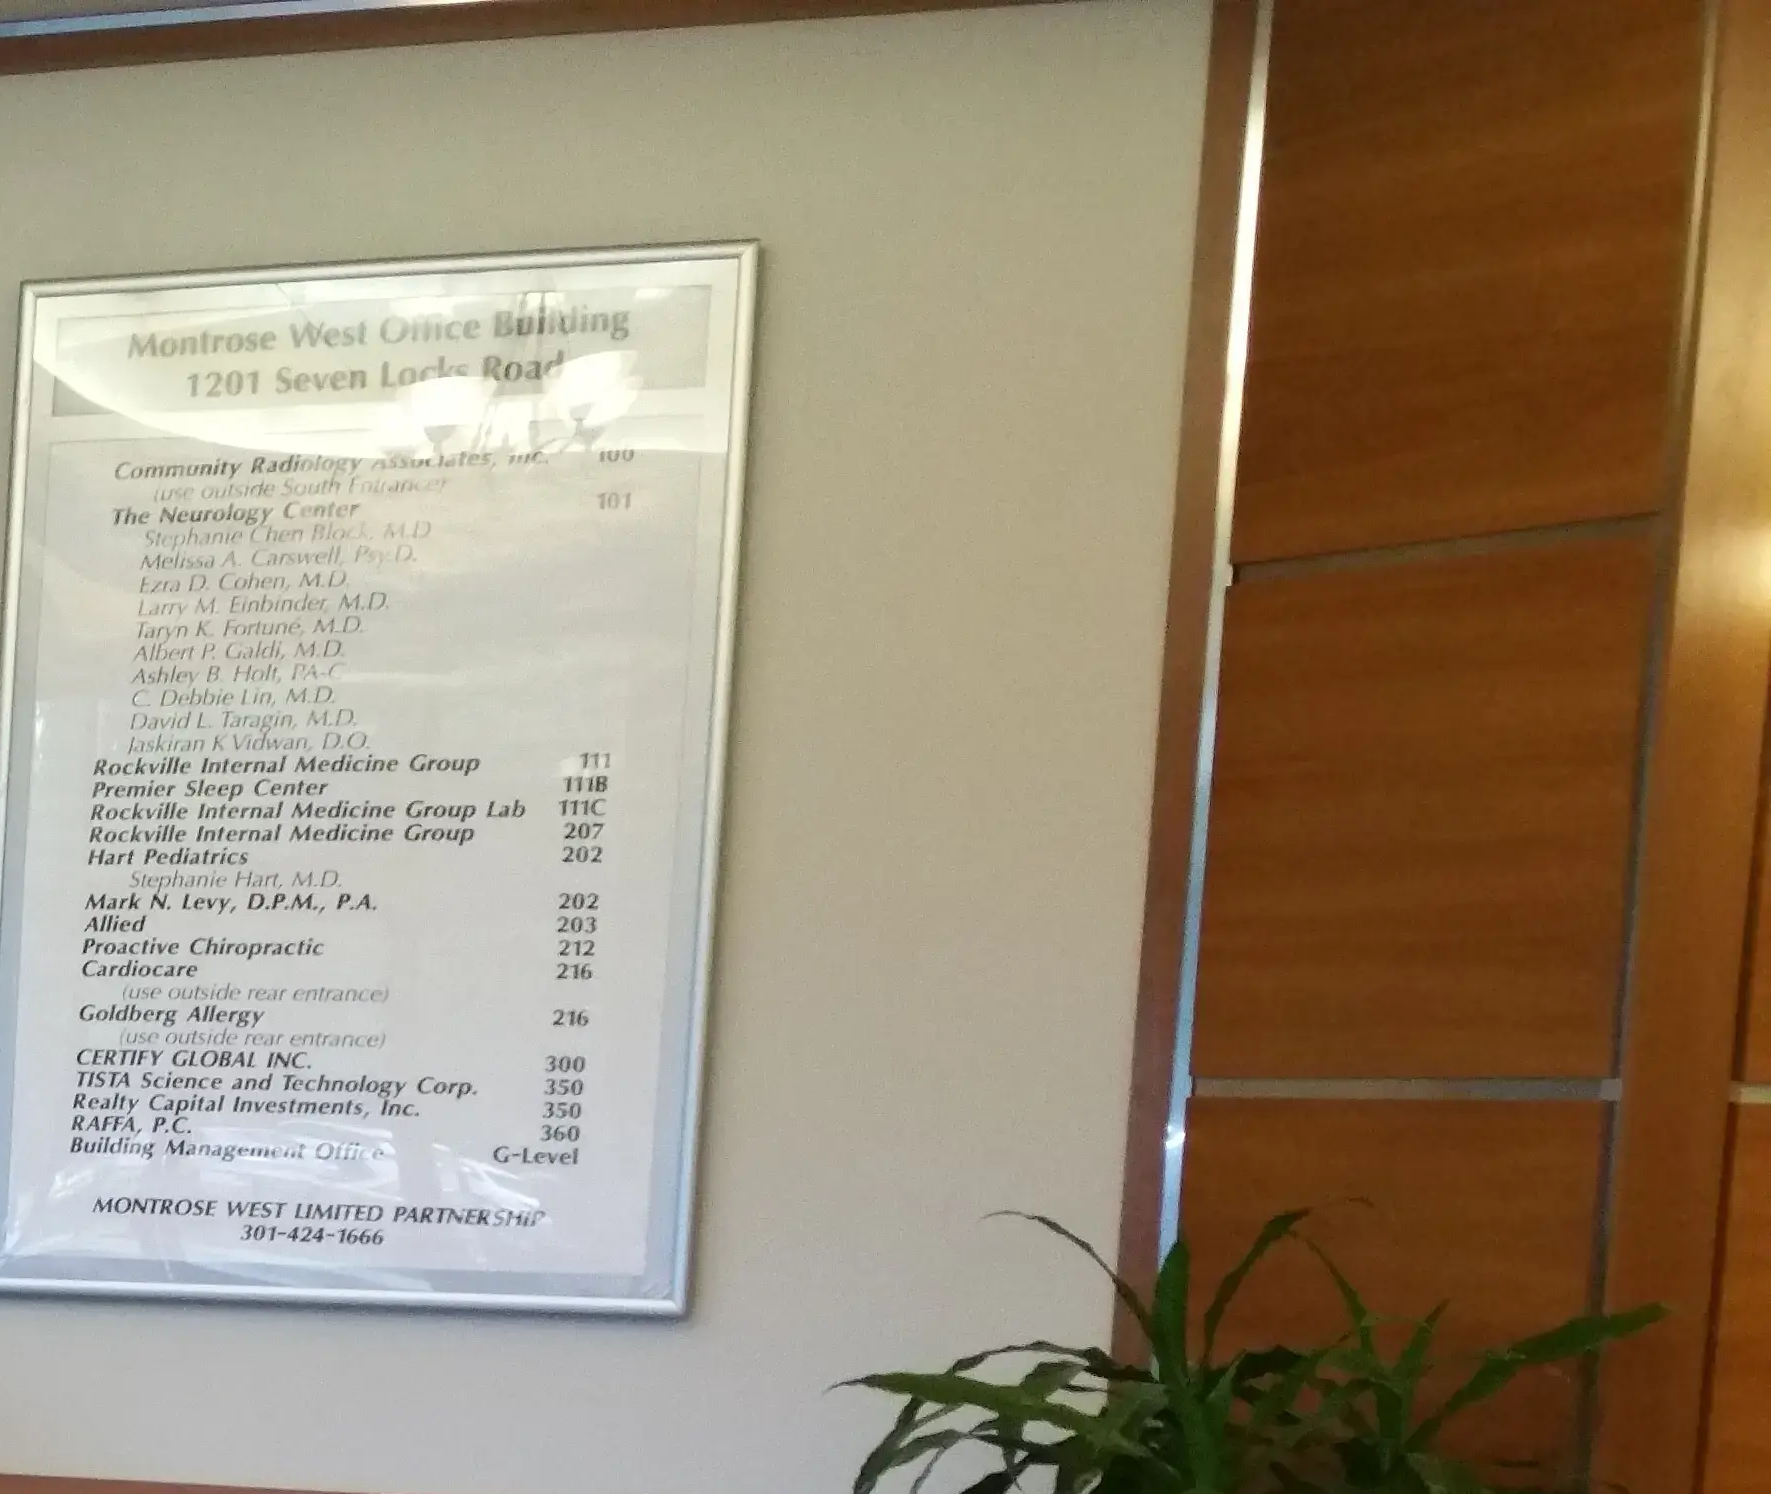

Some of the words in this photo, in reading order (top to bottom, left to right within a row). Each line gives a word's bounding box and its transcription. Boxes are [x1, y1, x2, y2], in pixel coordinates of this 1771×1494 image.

[127, 328, 276, 359] Montrose
[289, 322, 367, 348] West
[492, 308, 629, 341] Building
[187, 371, 260, 397] 1201
[275, 367, 366, 394] Seven
[114, 461, 242, 480] Community
[251, 455, 362, 475] Radiology
[112, 507, 150, 525] The
[159, 506, 273, 526] Neurology
[283, 501, 360, 519] Center
[598, 492, 632, 509] 101
[133, 645, 195, 662] Albert
[93, 757, 192, 776] Rockville
[201, 756, 286, 773] Internal
[295, 755, 399, 773] Medicine
[409, 753, 481, 776] Group
[580, 752, 610, 769] 111
[92, 781, 176, 798] Premier
[184, 780, 244, 801] Sleep
[254, 780, 328, 797] Center
[564, 776, 608, 792] 111B
[91, 803, 188, 821] Rockville
[198, 803, 284, 820] Internal
[290, 802, 395, 819] Medicine
[405, 801, 476, 822] Group
[487, 801, 525, 818] Lab
[559, 799, 607, 816] 111C
[89, 827, 187, 844] Rockville
[196, 825, 280, 842] Internal
[289, 825, 394, 842] Medicine
[404, 824, 475, 845] Group
[564, 823, 605, 840] 207
[88, 849, 134, 866] Hart
[143, 848, 248, 866] Pediatrics
[562, 847, 603, 863] 202
[84, 894, 139, 910] Mark
[150, 894, 172, 910] N.
[182, 894, 237, 913] Levy,
[247, 894, 326, 912] D.P.M.,
[336, 894, 377, 910] P.A.
[559, 893, 599, 910] 202
[84, 915, 146, 933] Allied
[558, 917, 598, 933] 203
[82, 938, 179, 955] Proactive
[189, 938, 324, 959] Chiropractic
[558, 940, 595, 957] 212
[82, 960, 198, 977] Cardiocare
[557, 963, 592, 980] 216
[79, 1005, 177, 1026] Goldberg
[187, 1005, 265, 1026] Allergy
[553, 1010, 589, 1026] 216
[76, 1049, 164, 1067] CERTIFY
[172, 1050, 257, 1069] GLOBAL
[266, 1052, 312, 1070] INC.
[545, 1056, 586, 1073] 300
[76, 1071, 131, 1089] TISTA
[141, 1072, 222, 1091] Science
[232, 1075, 272, 1093] and
[282, 1075, 406, 1098] Technology
[417, 1078, 478, 1099] Corp.
[544, 1079, 583, 1096] 350
[72, 1094, 139, 1114] Realty
[149, 1094, 224, 1114] Capital
[233, 1097, 370, 1118] Investments,
[380, 1100, 419, 1117] Inc.
[542, 1102, 582, 1119] 350
[71, 1117, 142, 1135] RAFFA,
[151, 1117, 191, 1134] P.C.
[539, 1126, 581, 1142] 360
[69, 1138, 155, 1158] Building
[165, 1140, 305, 1162] Management
[315, 1142, 384, 1161] Office
[493, 1146, 579, 1166] G-Level
[92, 1197, 218, 1218] MONTROSE
[227, 1201, 288, 1219] WEST
[295, 1204, 384, 1222] LIMITED
[393, 1206, 547, 1227] PARTNERSHIP
[240, 1224, 384, 1245] 301-424-1666
